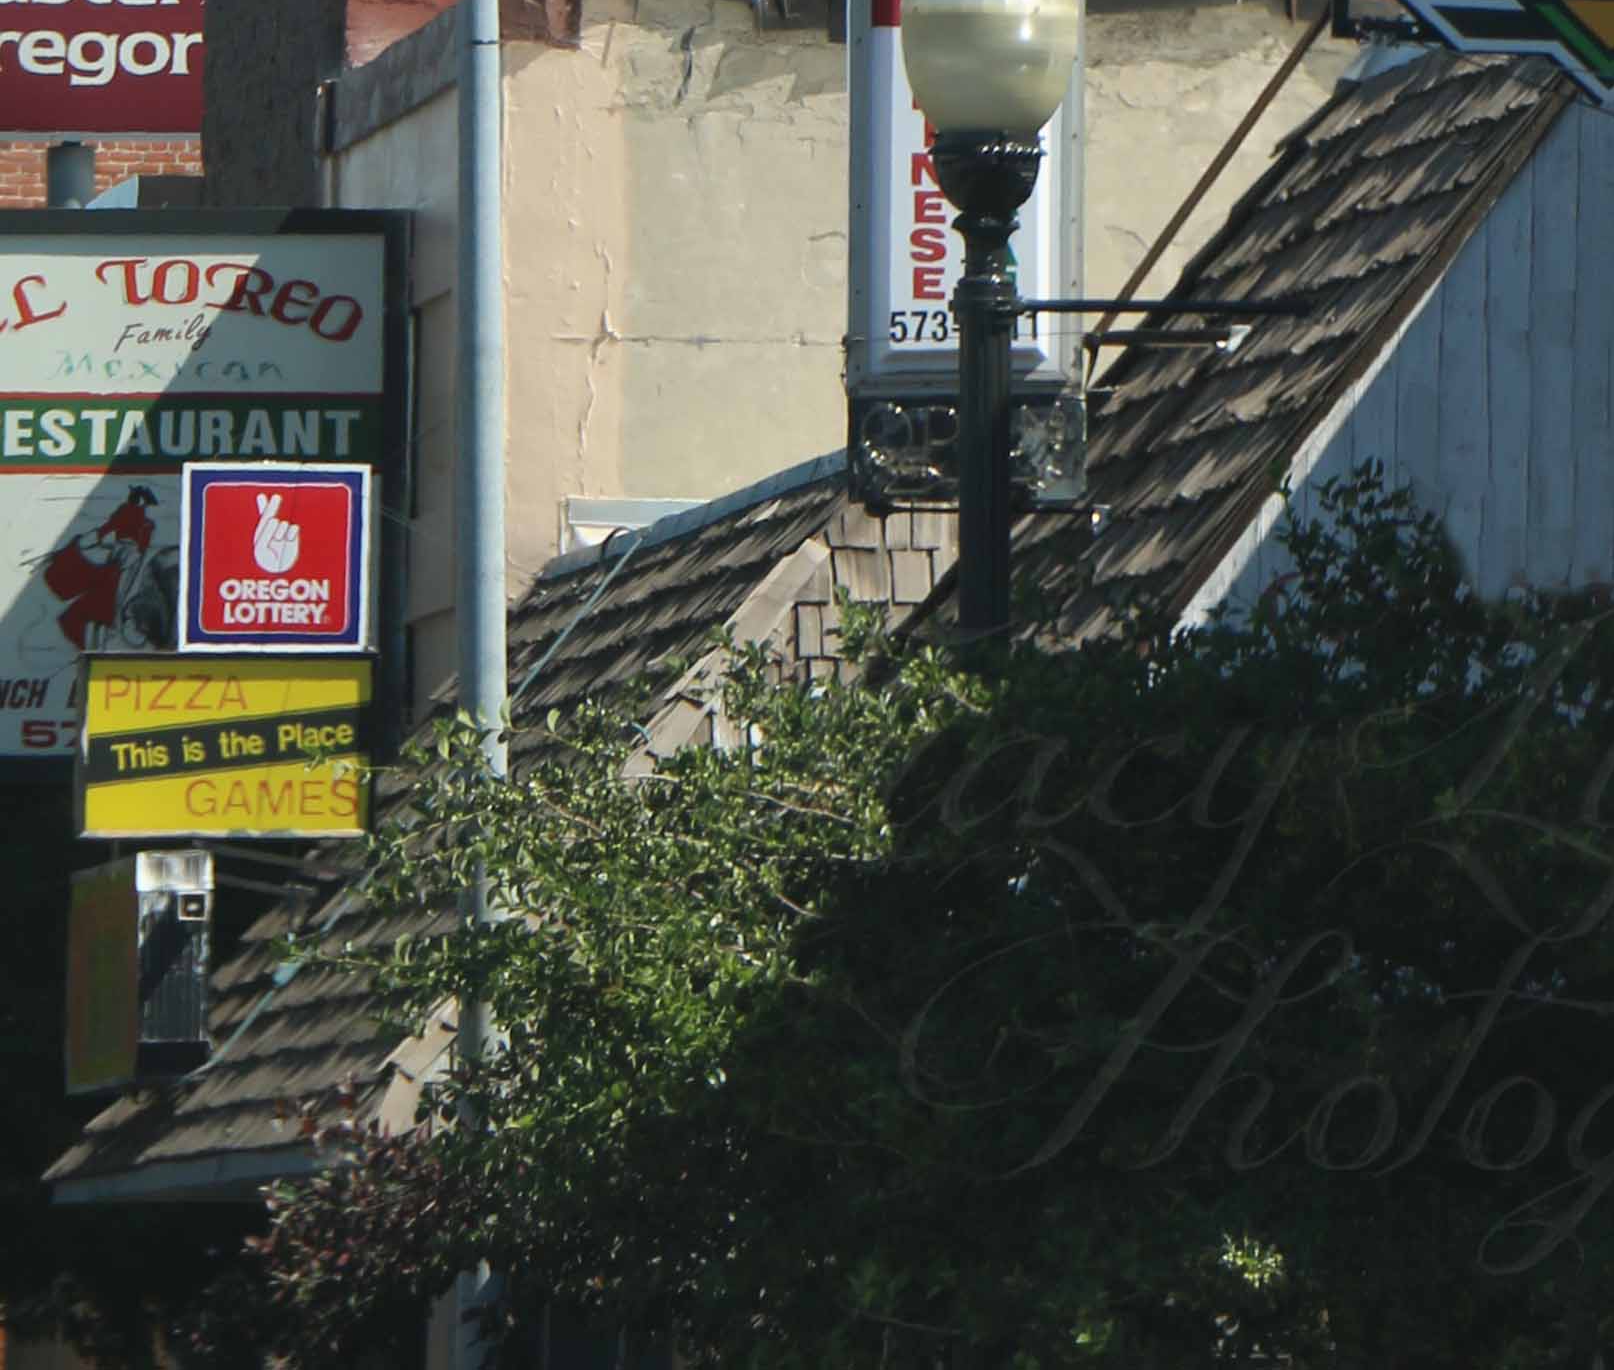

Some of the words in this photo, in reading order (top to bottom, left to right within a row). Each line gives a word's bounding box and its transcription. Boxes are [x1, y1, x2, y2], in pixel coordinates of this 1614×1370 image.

[95, 258, 364, 343] TOREO
[114, 313, 214, 352] Family
[0, 408, 361, 458] ESTAURANT
[218, 578, 331, 602] OREGON
[222, 602, 328, 626] LOTTERY
[103, 674, 248, 711] PIZZA
[110, 740, 170, 771] This
[181, 736, 206, 764] is
[218, 730, 265, 760] the
[277, 721, 355, 751] Place
[184, 779, 360, 818] GAMES
